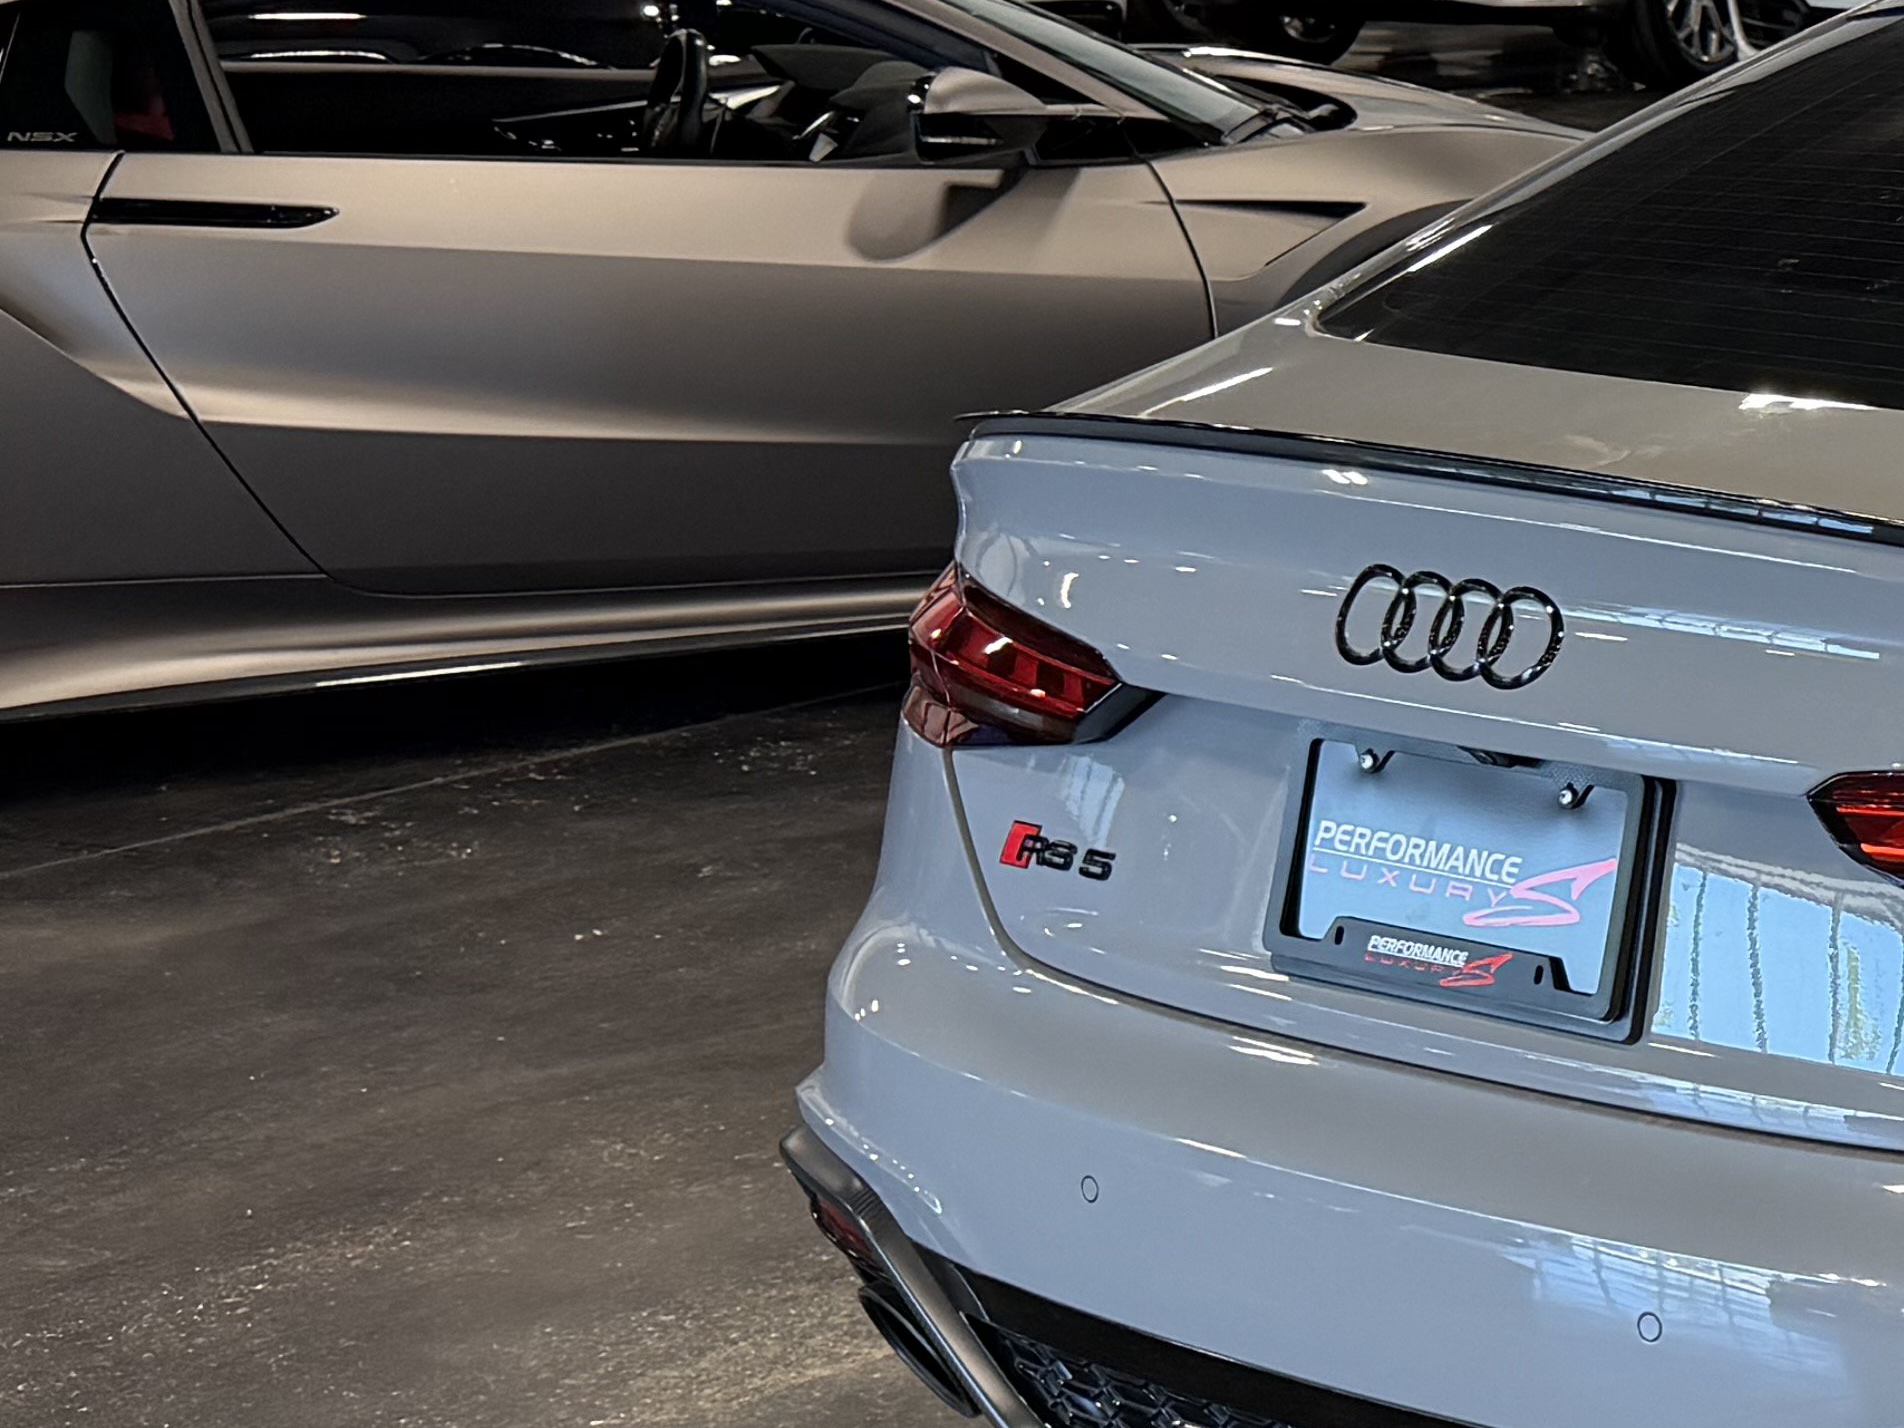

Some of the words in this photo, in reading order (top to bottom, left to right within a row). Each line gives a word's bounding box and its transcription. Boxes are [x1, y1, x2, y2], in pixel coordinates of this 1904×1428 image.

[7, 131, 78, 143] NSX
[1314, 821, 1523, 884] PERFORMANCE
[1367, 934, 1469, 966] PERFORMANCE
